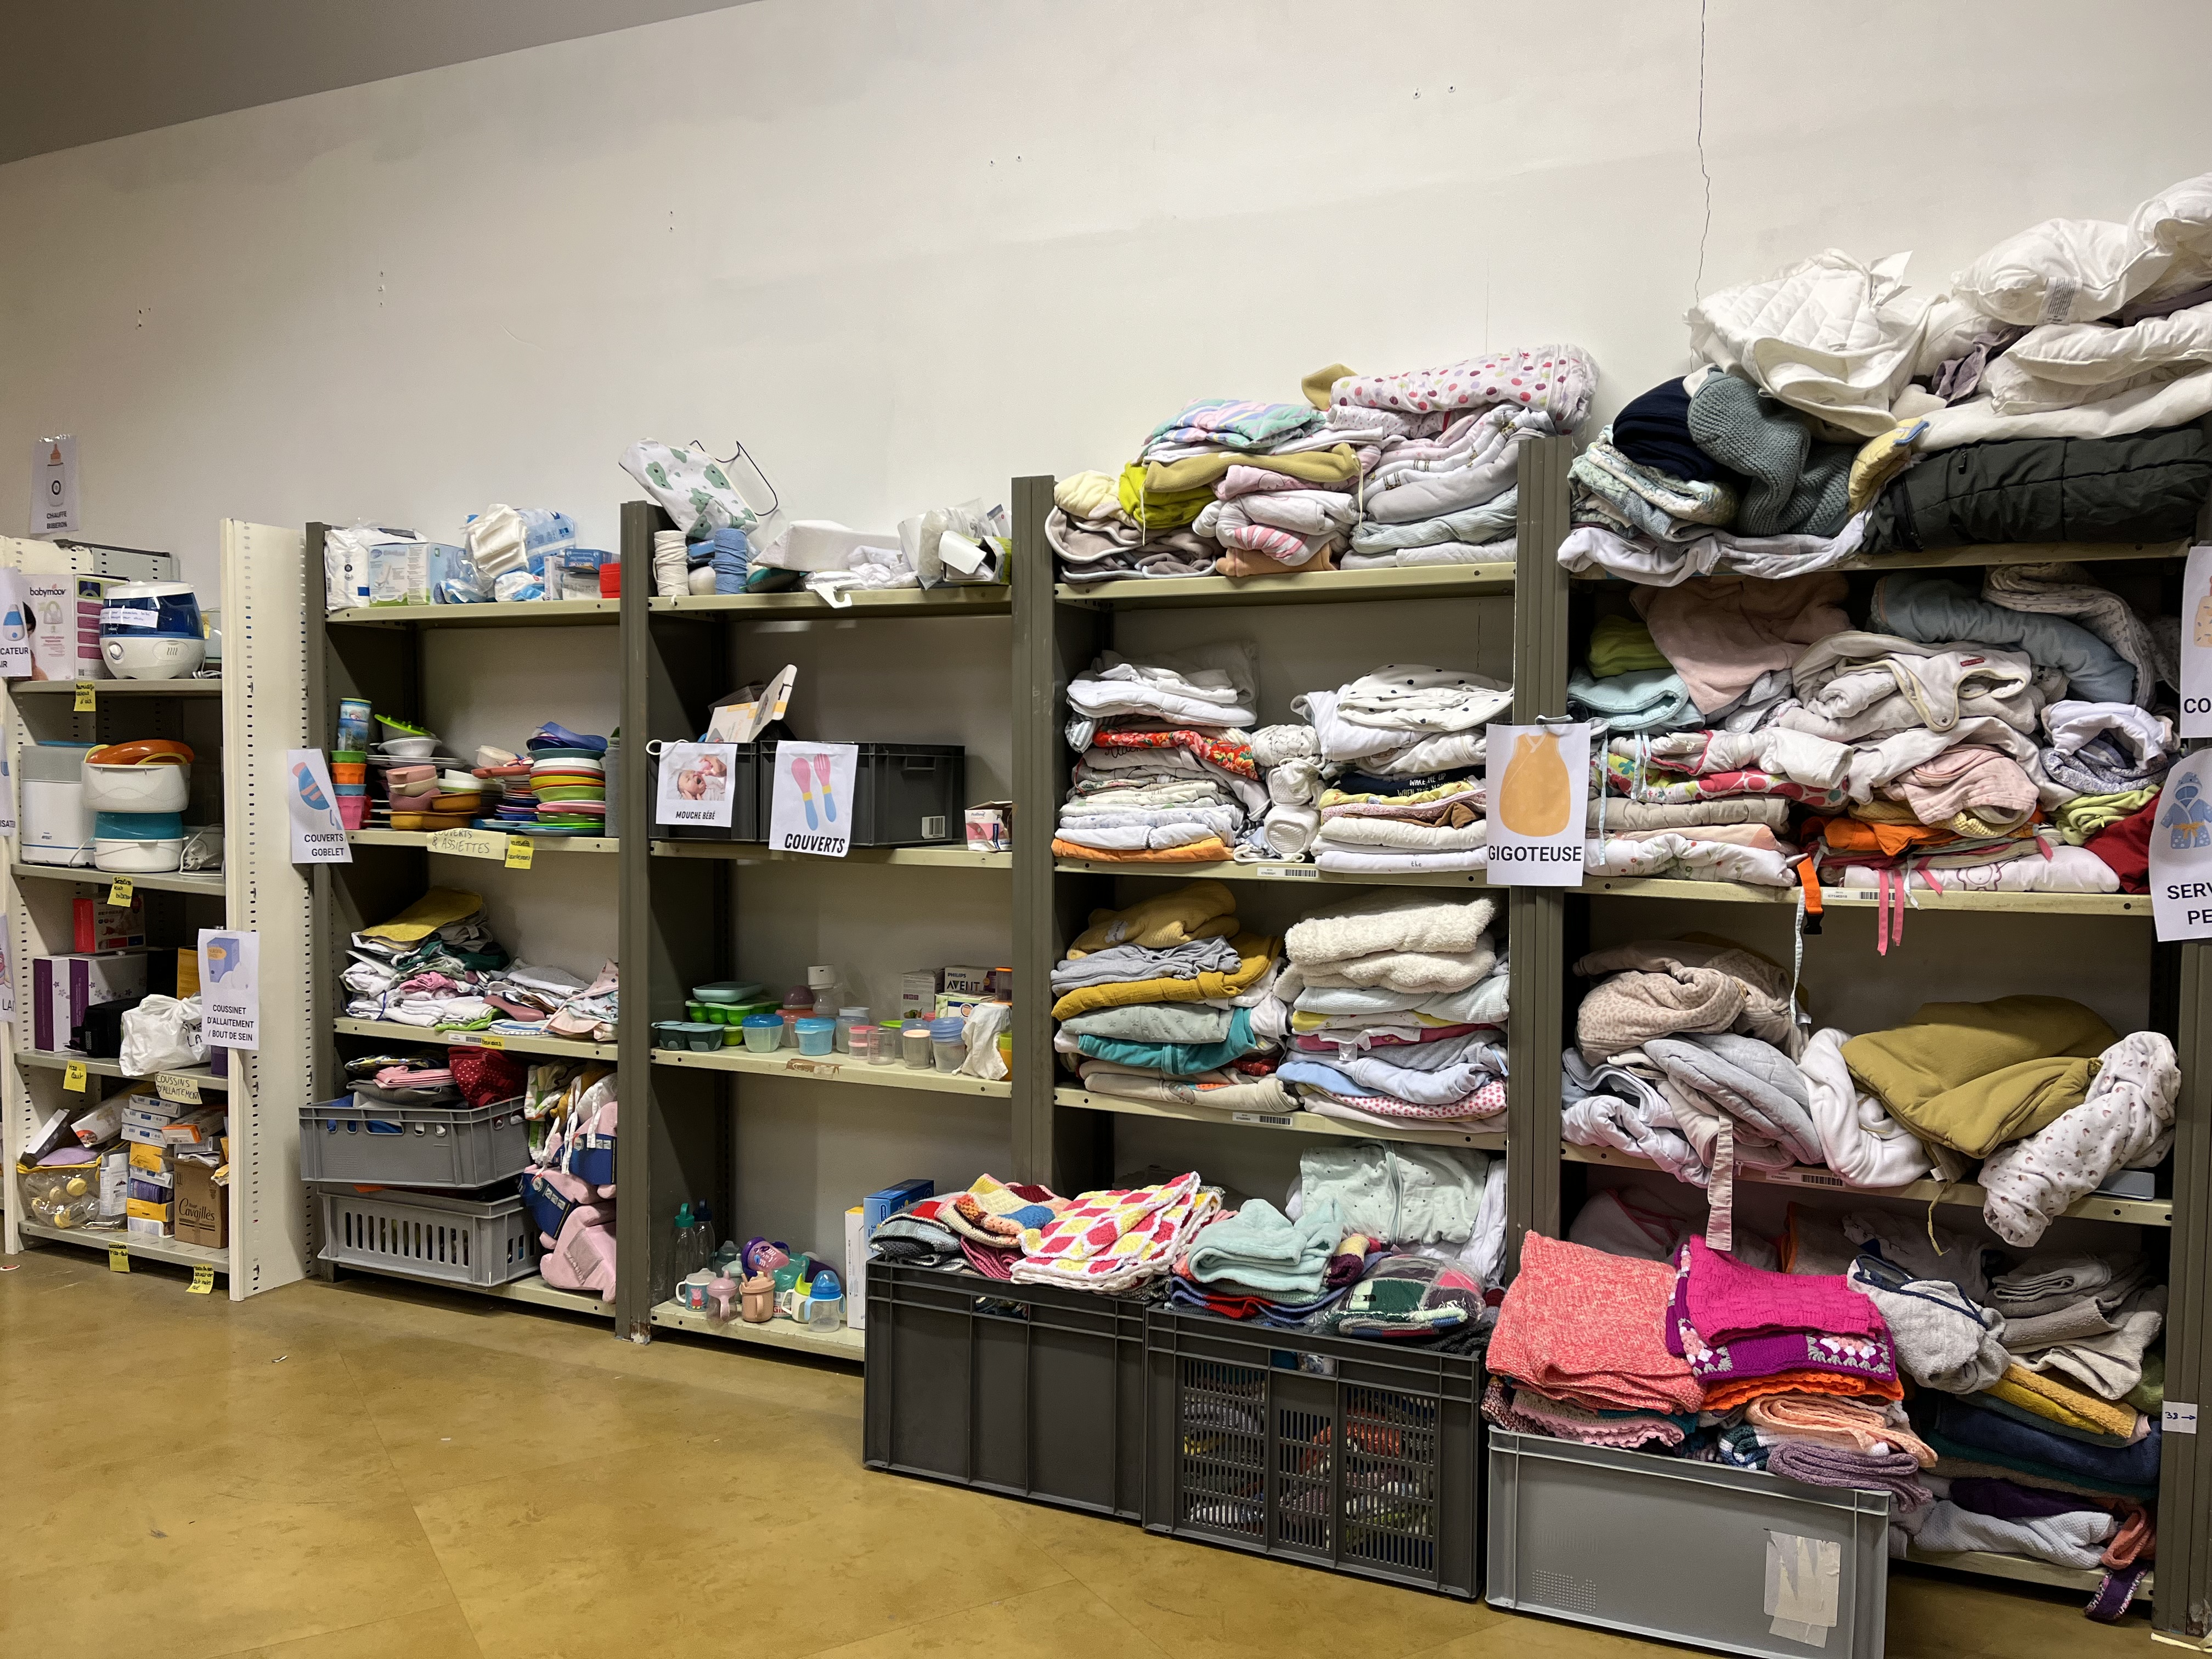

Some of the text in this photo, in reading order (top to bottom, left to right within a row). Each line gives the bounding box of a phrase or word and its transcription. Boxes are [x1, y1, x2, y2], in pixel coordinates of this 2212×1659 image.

[30, 587, 66, 597] babymoov
[2183, 698, 2211, 714] CO
[1427, 775, 1436, 783] ME
[1438, 772, 1446, 781] UP
[675, 810, 715, 820] MOUCHE BÉBÉ
[304, 833, 343, 843] COUVERTS
[785, 833, 845, 853] COUVERTS
[431, 836, 490, 854] & ASSIETTES
[312, 848, 344, 856] GOBELET
[1488, 845, 1582, 862] GIGOTEUSE
[947, 980, 980, 992] AVENT
[213, 1005, 247, 1015] COUSSINET
[207, 1017, 255, 1029] D'ALLAITEMENT
[212, 1030, 228, 1039] BOUT
[229, 1031, 237, 1040] DE
[238, 1032, 253, 1041] SEIN
[156, 1074, 190, 1087] COUSSINS
[156, 1085, 200, 1100] D'ALLAITEMENT
[179, 1198, 215, 1221] Cavaillès
